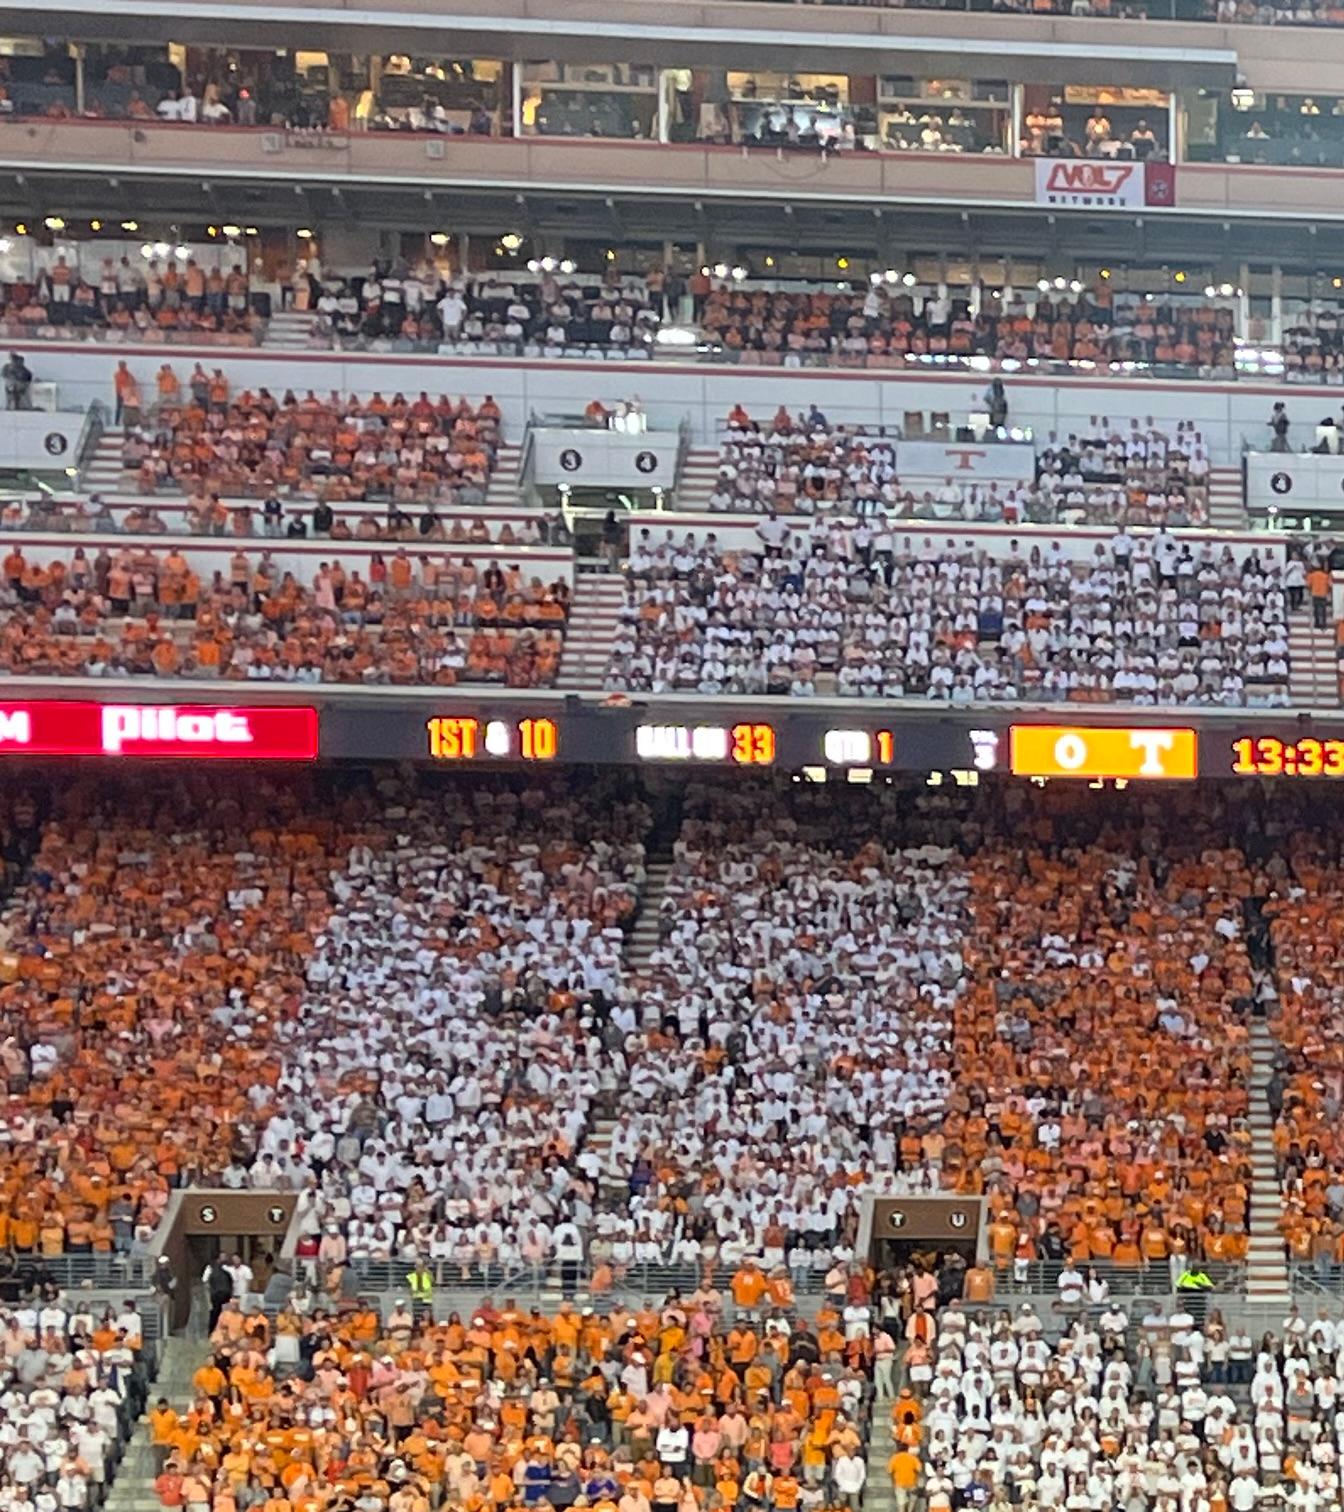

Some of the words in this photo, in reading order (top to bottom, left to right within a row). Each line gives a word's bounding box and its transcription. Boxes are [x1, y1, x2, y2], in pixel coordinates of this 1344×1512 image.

[945, 450, 986, 470] T
[427, 718, 478, 758] 1ST
[519, 719, 556, 758] 10
[732, 722, 774, 764] 33
[877, 730, 893, 764] 1
[1129, 732, 1174, 774] T
